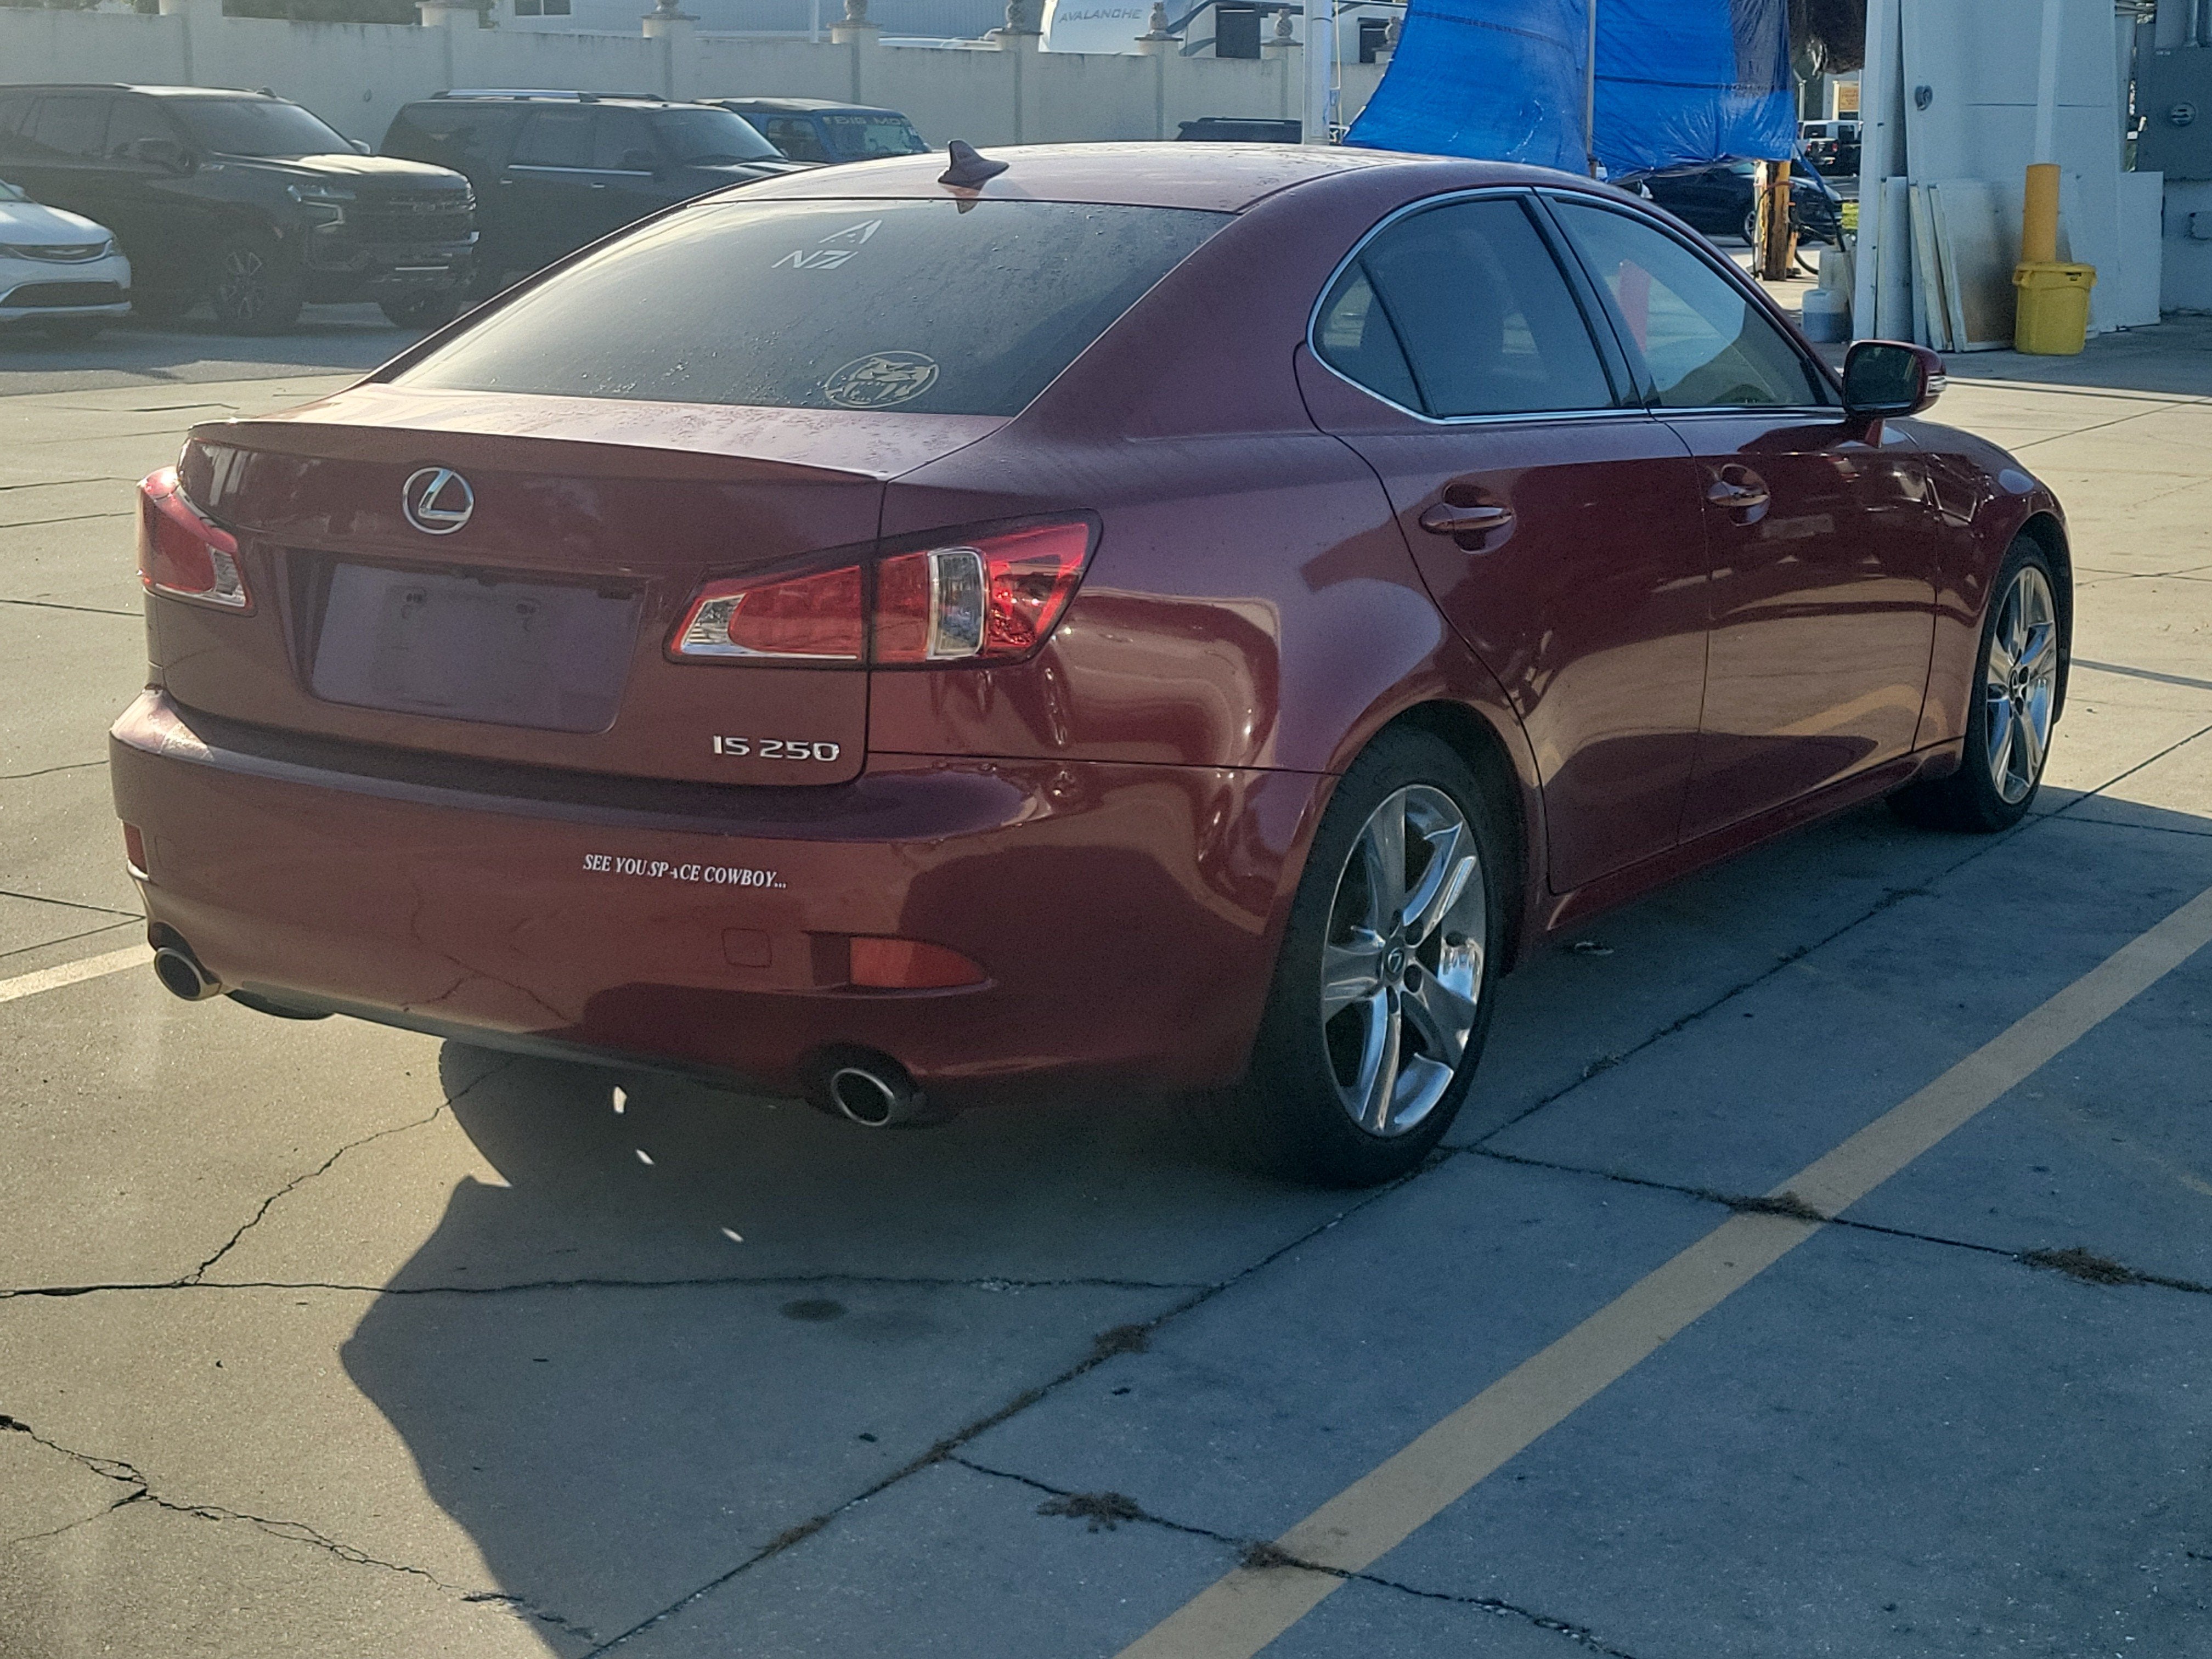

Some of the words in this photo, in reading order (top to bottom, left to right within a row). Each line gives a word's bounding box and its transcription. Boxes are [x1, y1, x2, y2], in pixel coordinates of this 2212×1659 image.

[1059, 8, 1143, 23] AVALANCHE
[713, 735, 751, 755] IS
[759, 739, 840, 761] 250
[583, 854, 612, 871] SEE
[615, 857, 648, 875] YOU
